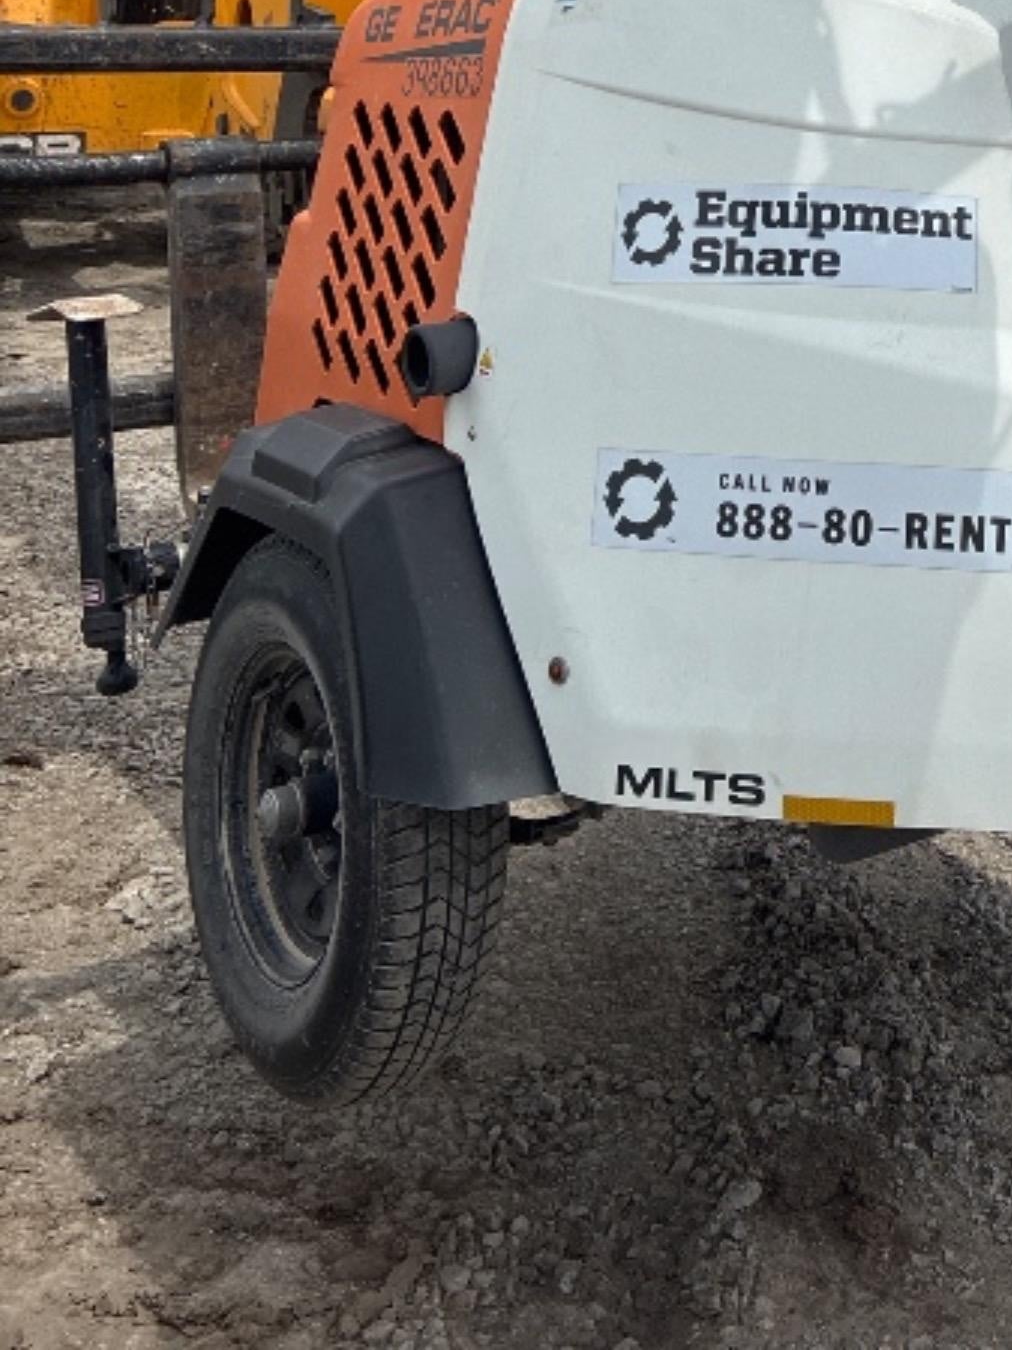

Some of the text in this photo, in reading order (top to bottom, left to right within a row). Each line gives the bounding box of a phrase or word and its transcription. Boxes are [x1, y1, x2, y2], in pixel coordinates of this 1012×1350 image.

[694, 191, 973, 240] Equipment
[689, 236, 841, 277] Share
[719, 473, 830, 496] CALL NOW
[615, 763, 766, 807] MLTS
